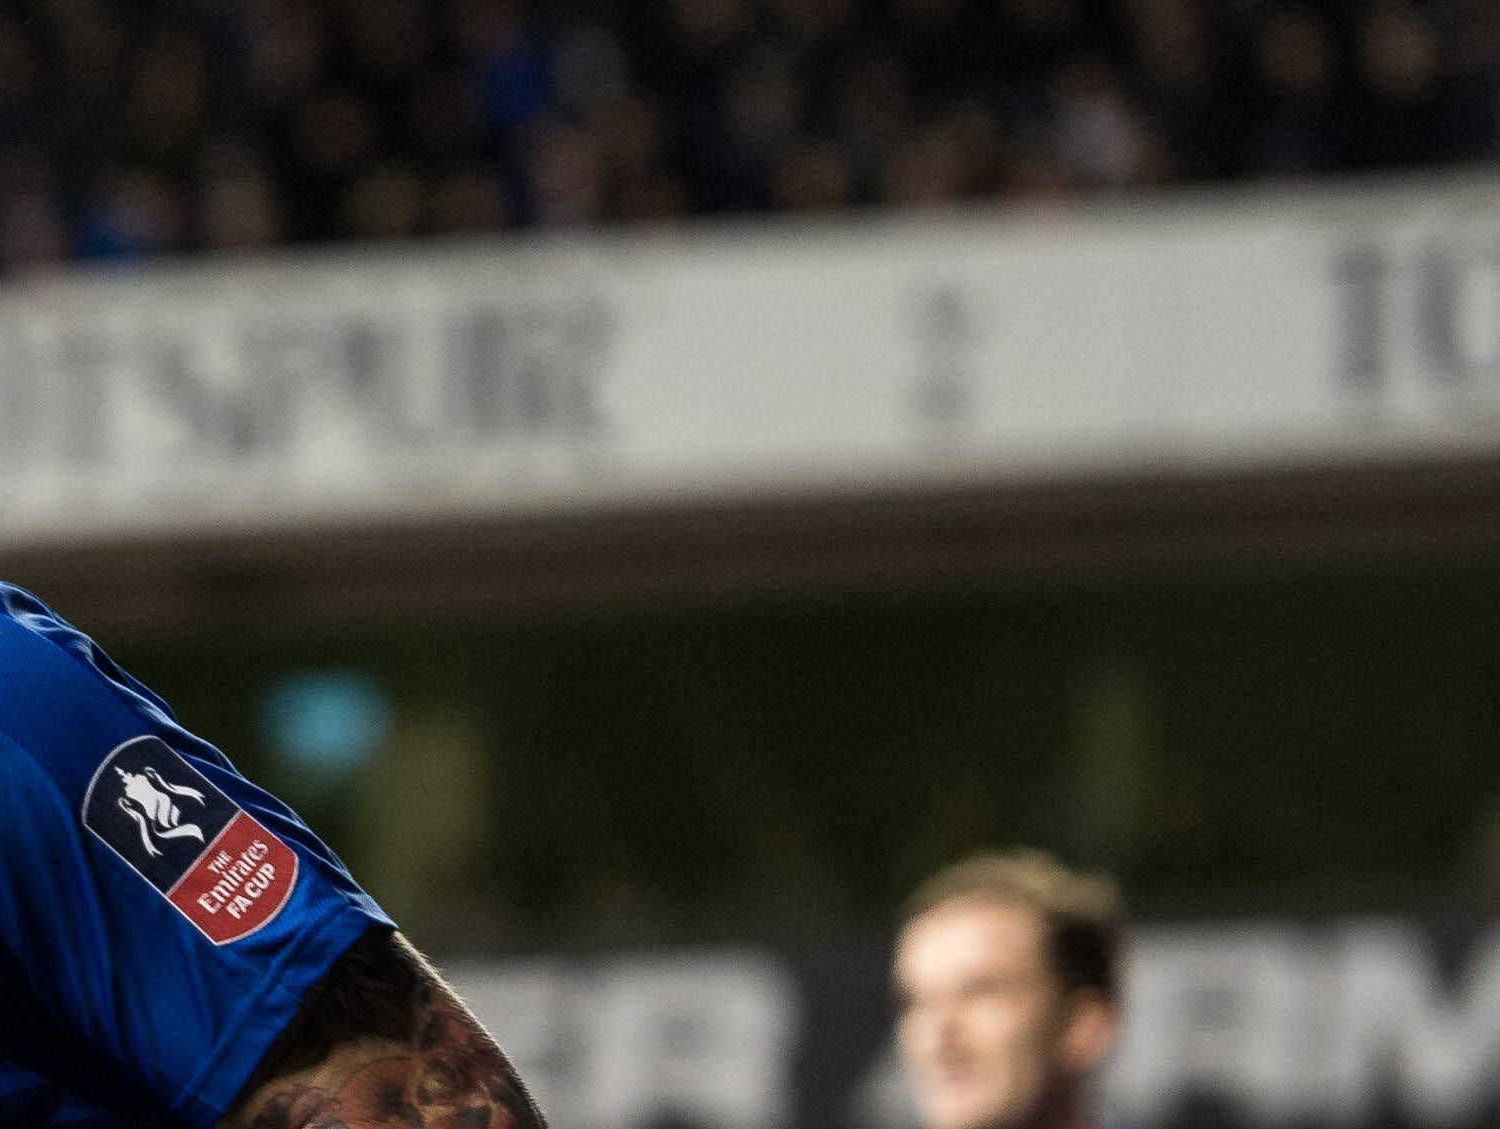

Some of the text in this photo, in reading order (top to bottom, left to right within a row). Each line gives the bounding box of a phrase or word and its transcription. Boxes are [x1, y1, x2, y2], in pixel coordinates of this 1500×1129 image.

[196, 839, 269, 914] Emirates
[207, 850, 233, 874] THE
[225, 862, 276, 920] FA CUP
